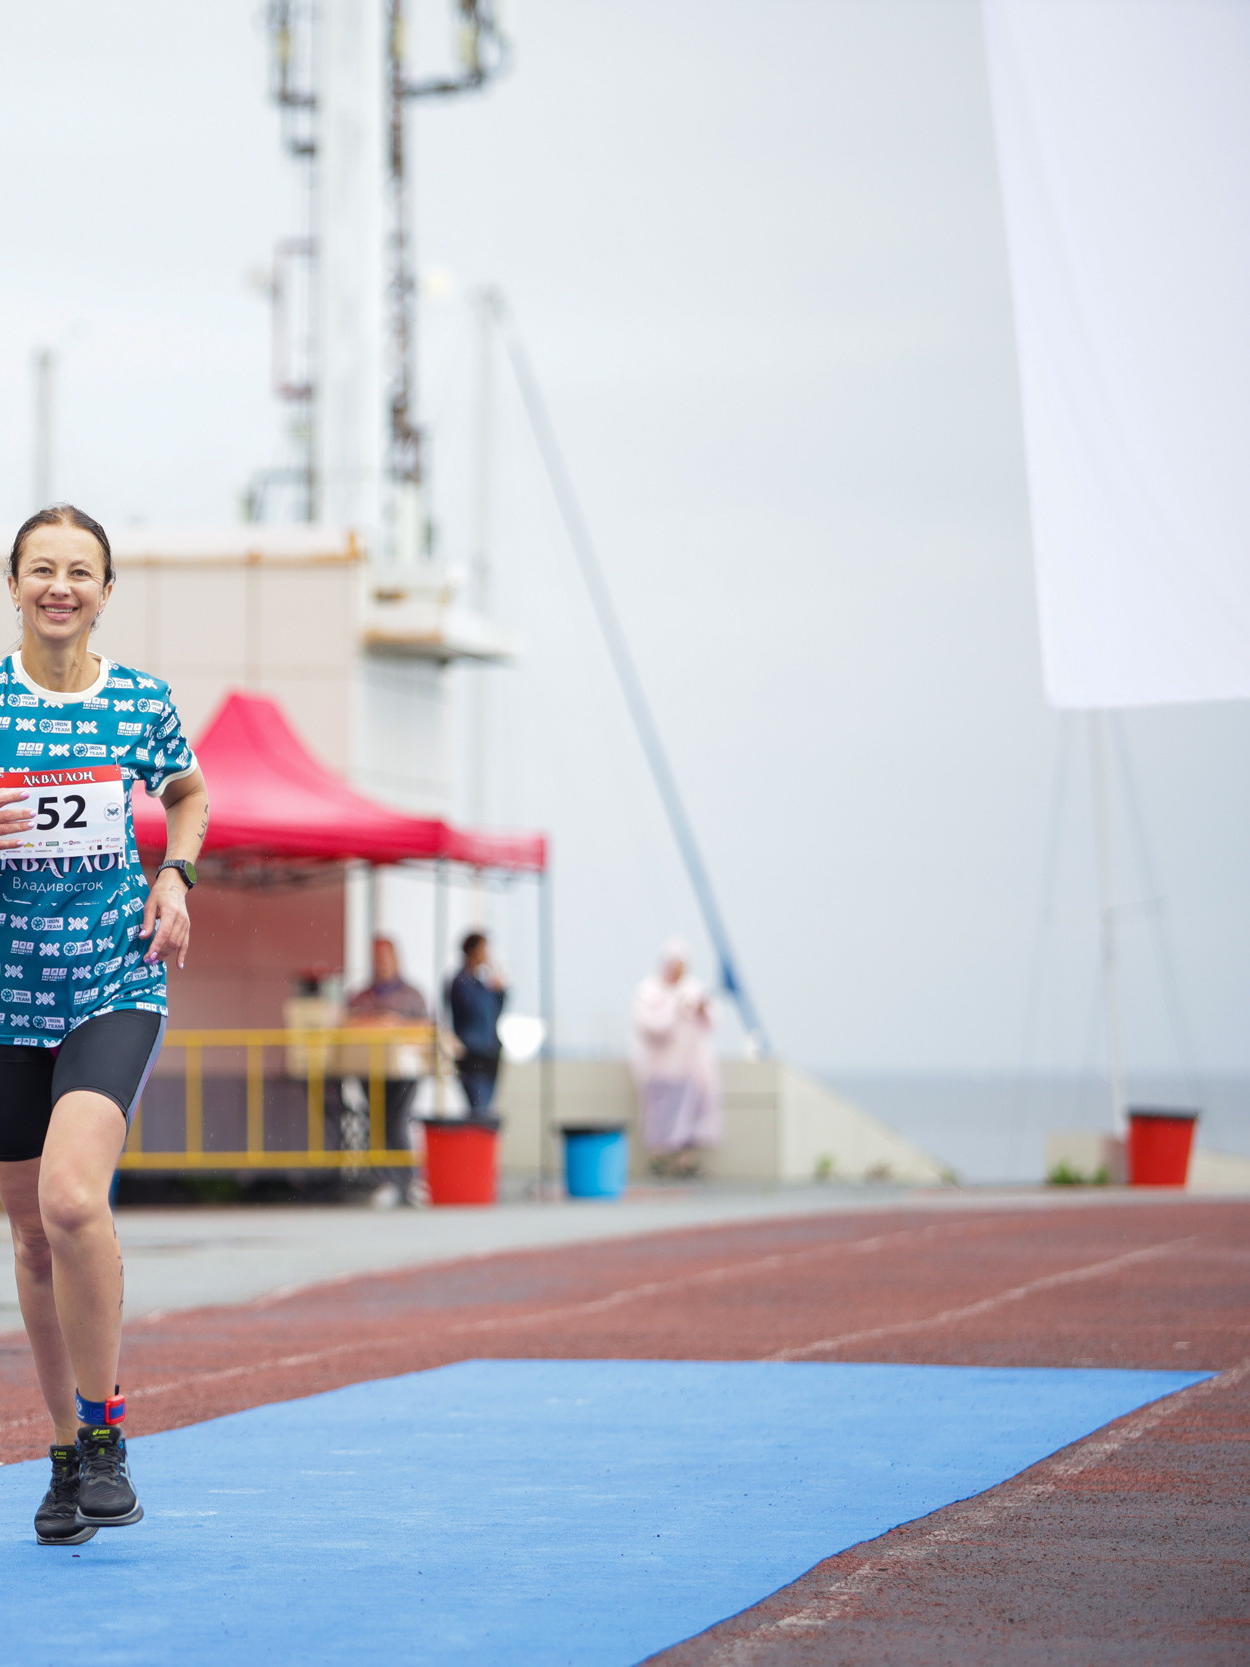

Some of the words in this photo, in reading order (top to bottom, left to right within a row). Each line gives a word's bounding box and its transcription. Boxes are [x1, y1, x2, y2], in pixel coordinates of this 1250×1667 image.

[23, 771, 96, 786] АКВАТЛОН
[36, 795, 87, 830] 52
[13, 877, 103, 893] Владивосток
